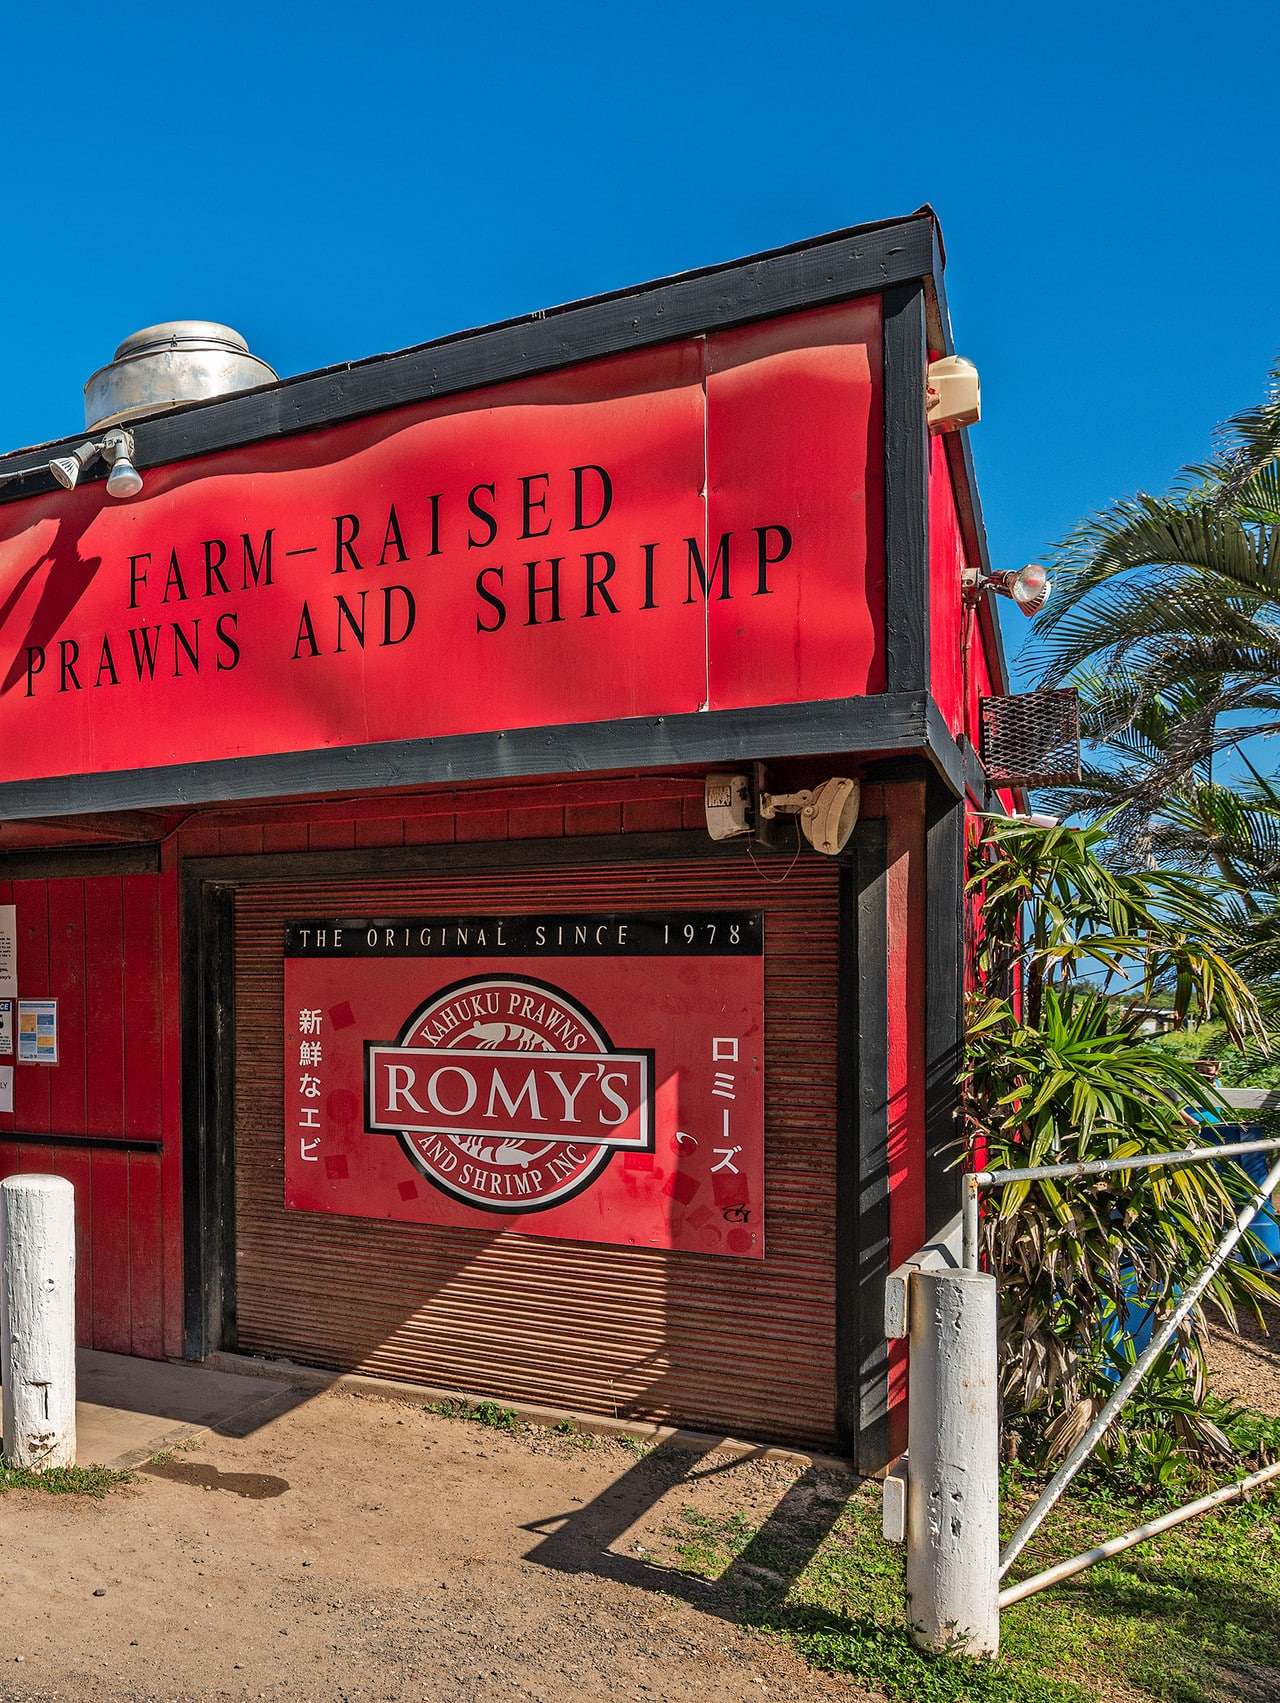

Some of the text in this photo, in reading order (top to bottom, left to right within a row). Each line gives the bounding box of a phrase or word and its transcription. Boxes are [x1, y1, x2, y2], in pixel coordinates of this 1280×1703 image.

[24, 523, 794, 698] PRAWNS AND SHRIMP
[299, 923, 742, 948] THE ORIGINAL SINCE 1978
[419, 992, 588, 1053] KAHUKU PRAWNS
[298, 1008, 323, 1163] 新鮮なエビ
[383, 1063, 629, 1127] ROMY'S
[710, 1036, 740, 1175] ロミーズ
[417, 1132, 589, 1197] AND SHRIMP INC
